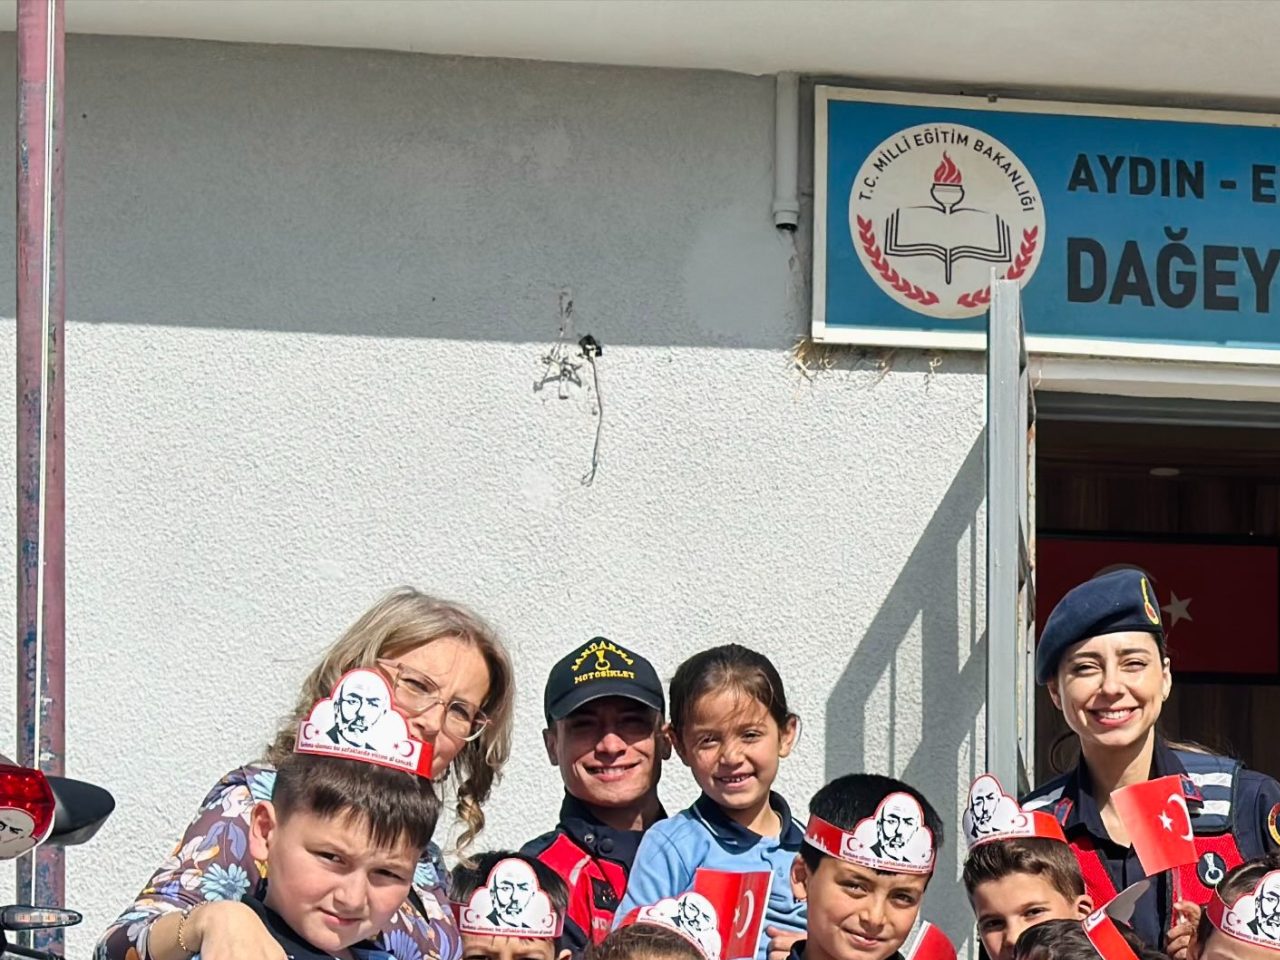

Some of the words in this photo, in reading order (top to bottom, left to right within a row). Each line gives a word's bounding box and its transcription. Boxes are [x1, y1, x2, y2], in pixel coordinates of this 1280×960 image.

[859, 175, 880, 200] T.C.
[873, 136, 911, 172] MİLLİ
[914, 128, 969, 146] EĞİTİM
[973, 139, 1036, 212] BAKANLIĞI
[1067, 154, 1204, 200] AYDIN
